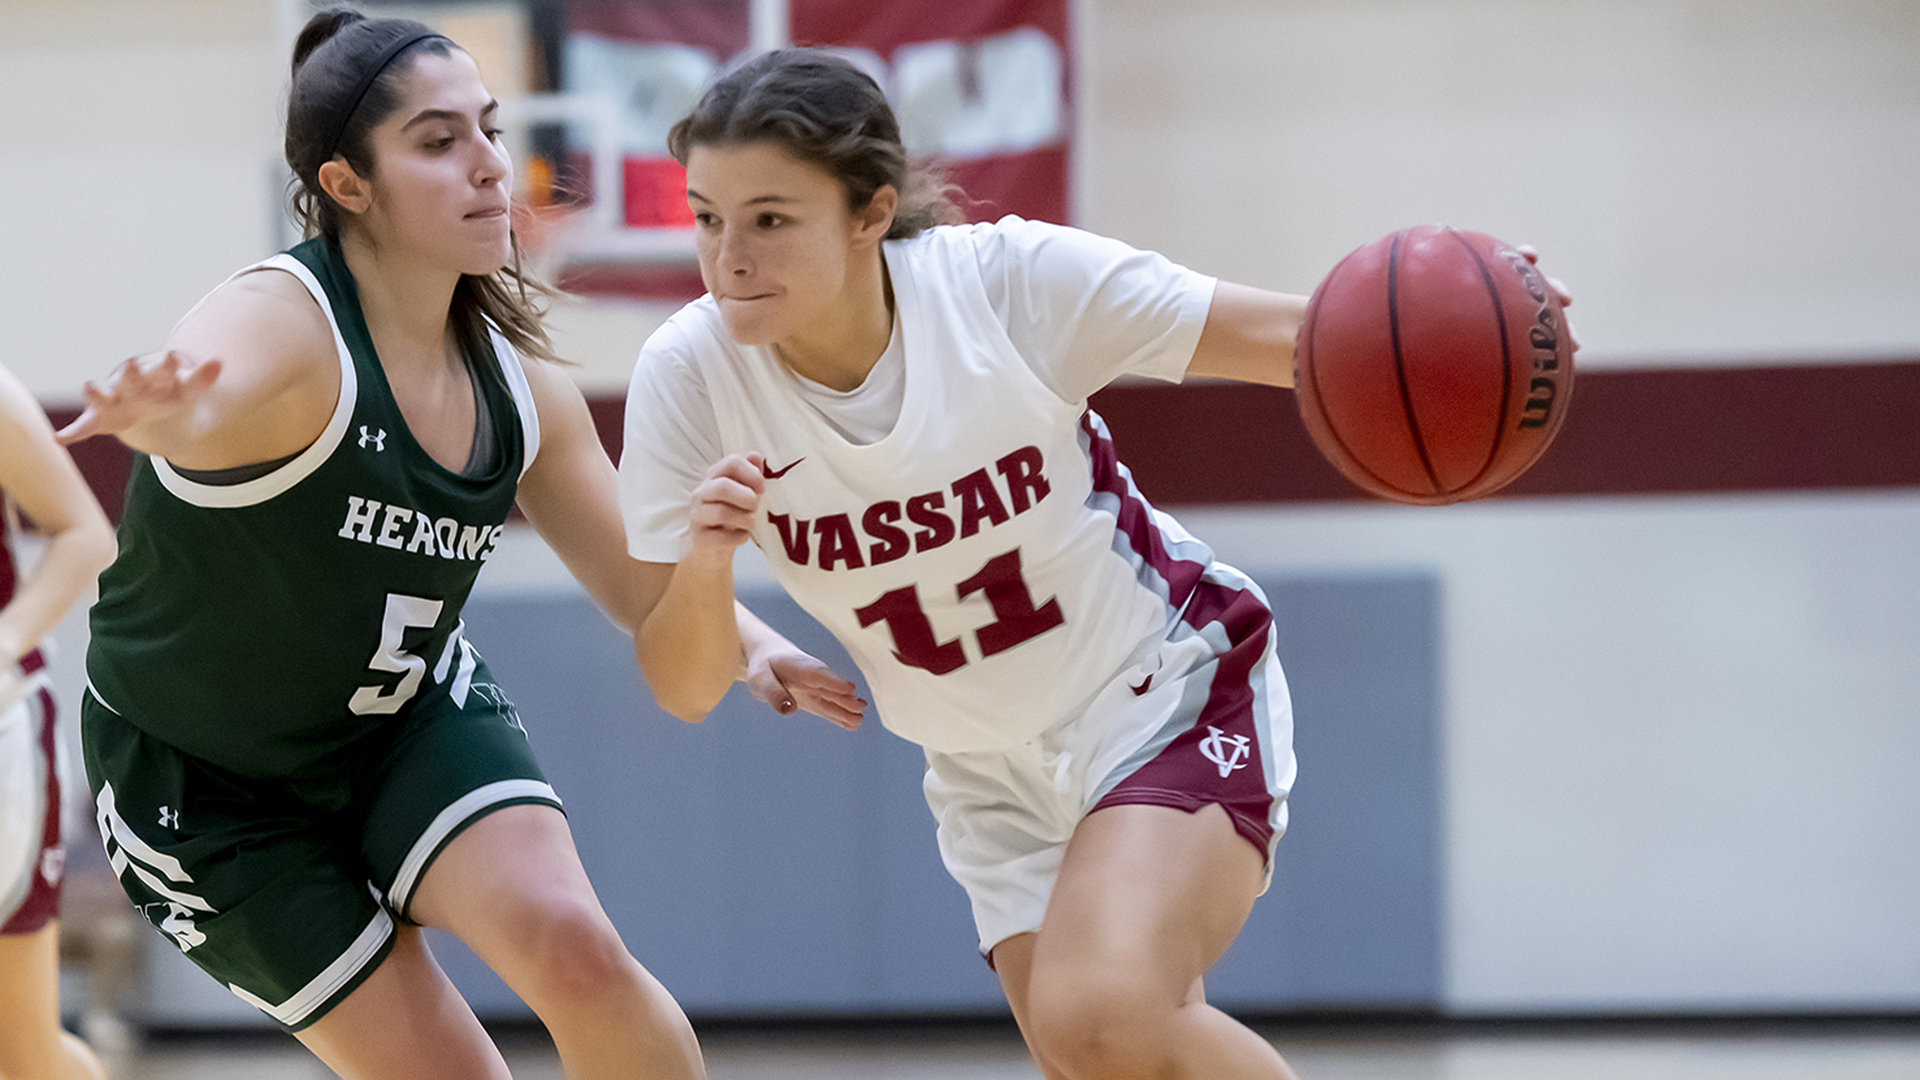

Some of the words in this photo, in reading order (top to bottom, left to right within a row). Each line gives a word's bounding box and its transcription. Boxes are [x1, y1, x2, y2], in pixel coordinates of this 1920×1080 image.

[338, 495, 505, 561] HERONS
[767, 445, 1051, 571] VASSAR
[853, 546, 1066, 676] 11
